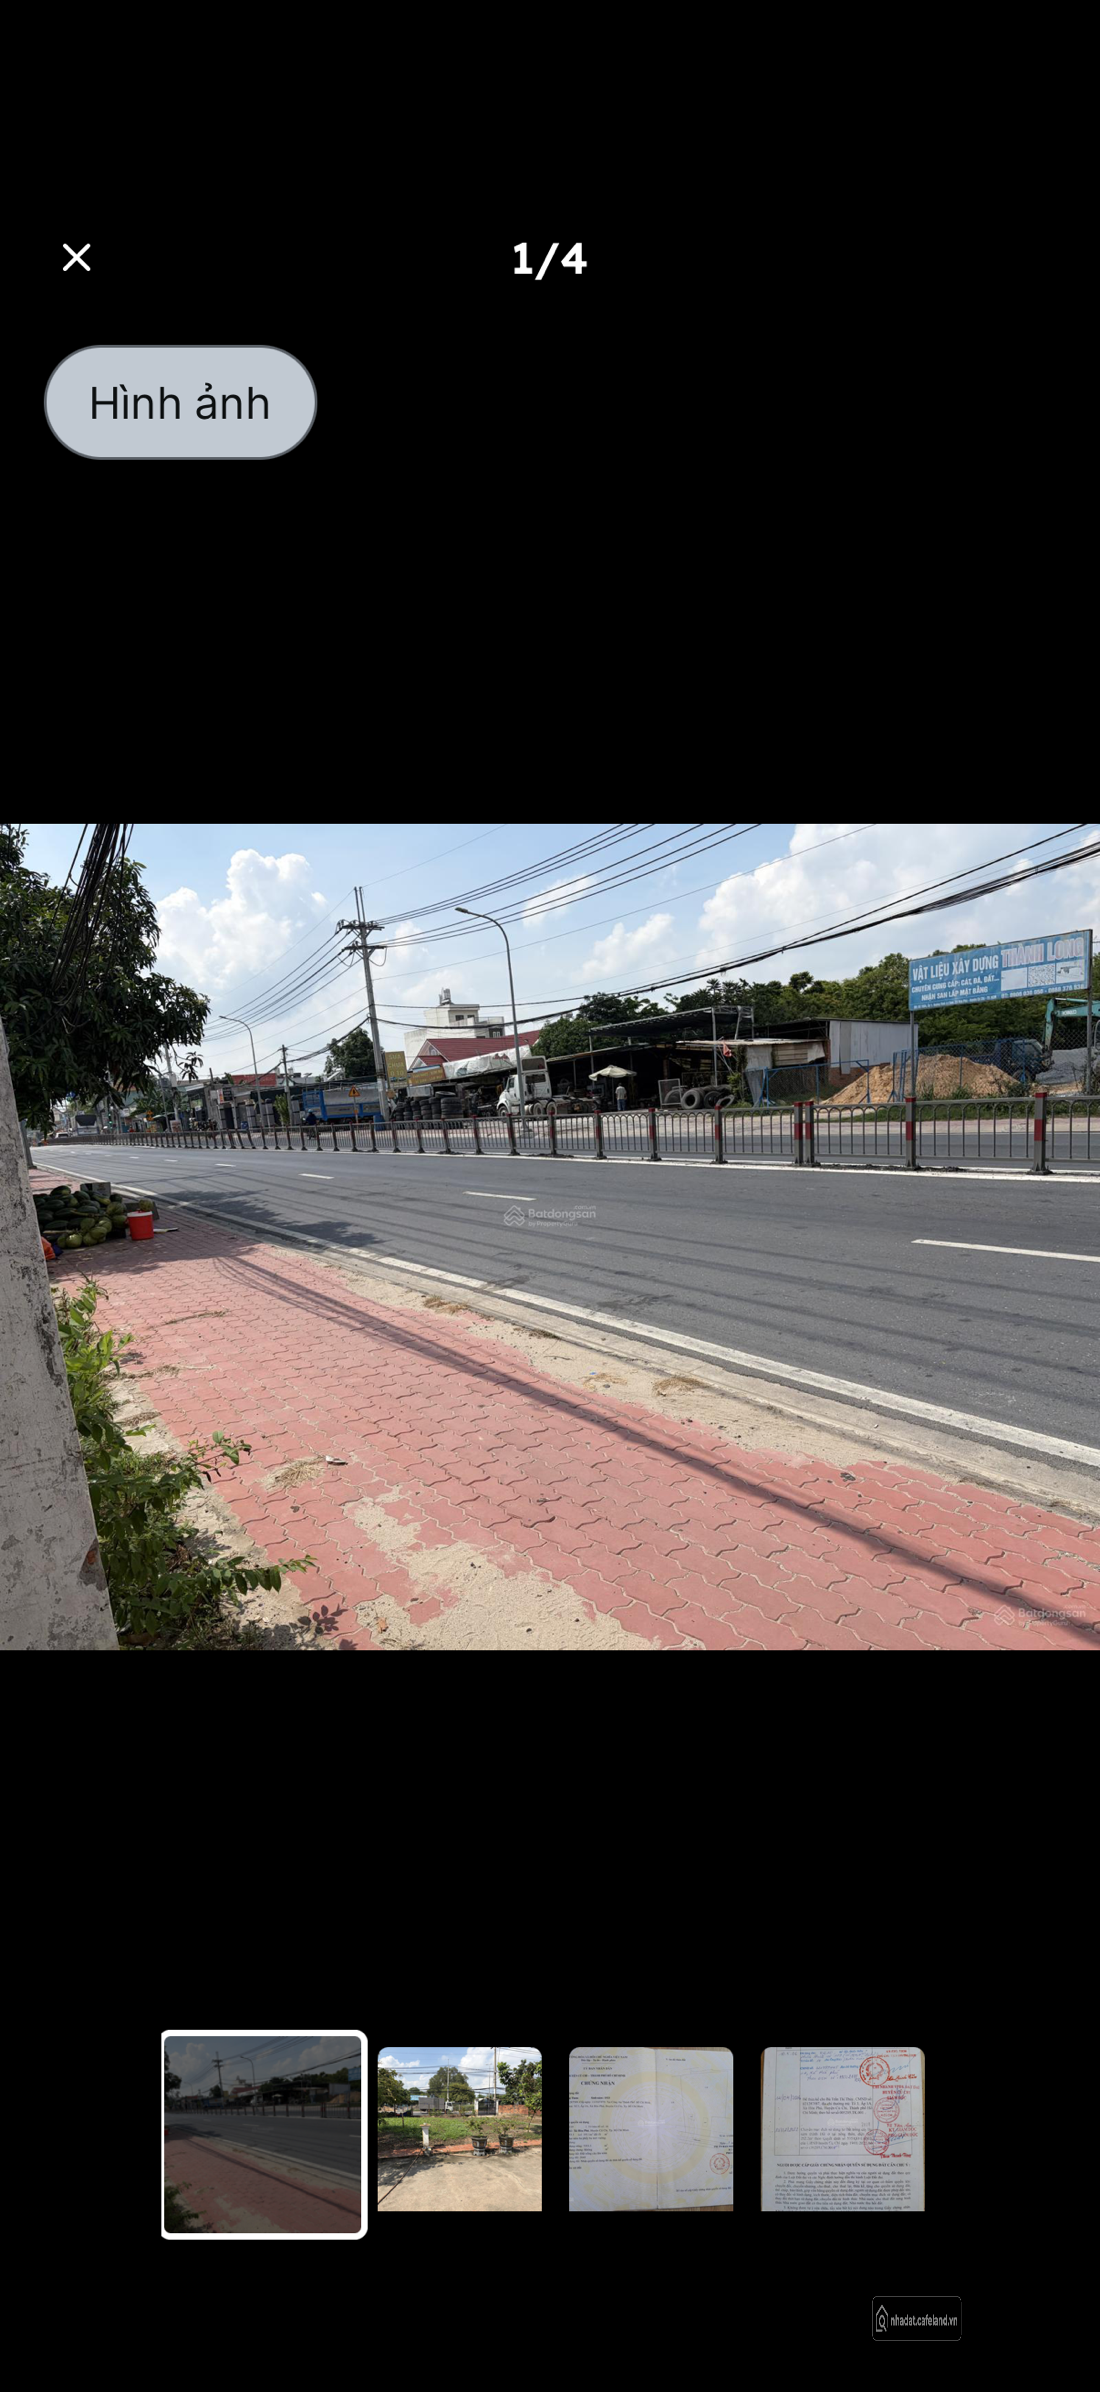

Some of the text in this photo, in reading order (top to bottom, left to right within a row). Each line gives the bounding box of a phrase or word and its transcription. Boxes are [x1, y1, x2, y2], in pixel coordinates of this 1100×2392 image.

[513, 242, 588, 280] 1/4
[91, 382, 269, 420] Hình ảnh
[1001, 937, 1084, 968] THÀNH LONG
[912, 954, 999, 983] VẬT LIỆU XÂY DỰNG
[937, 991, 948, 999] SAN
